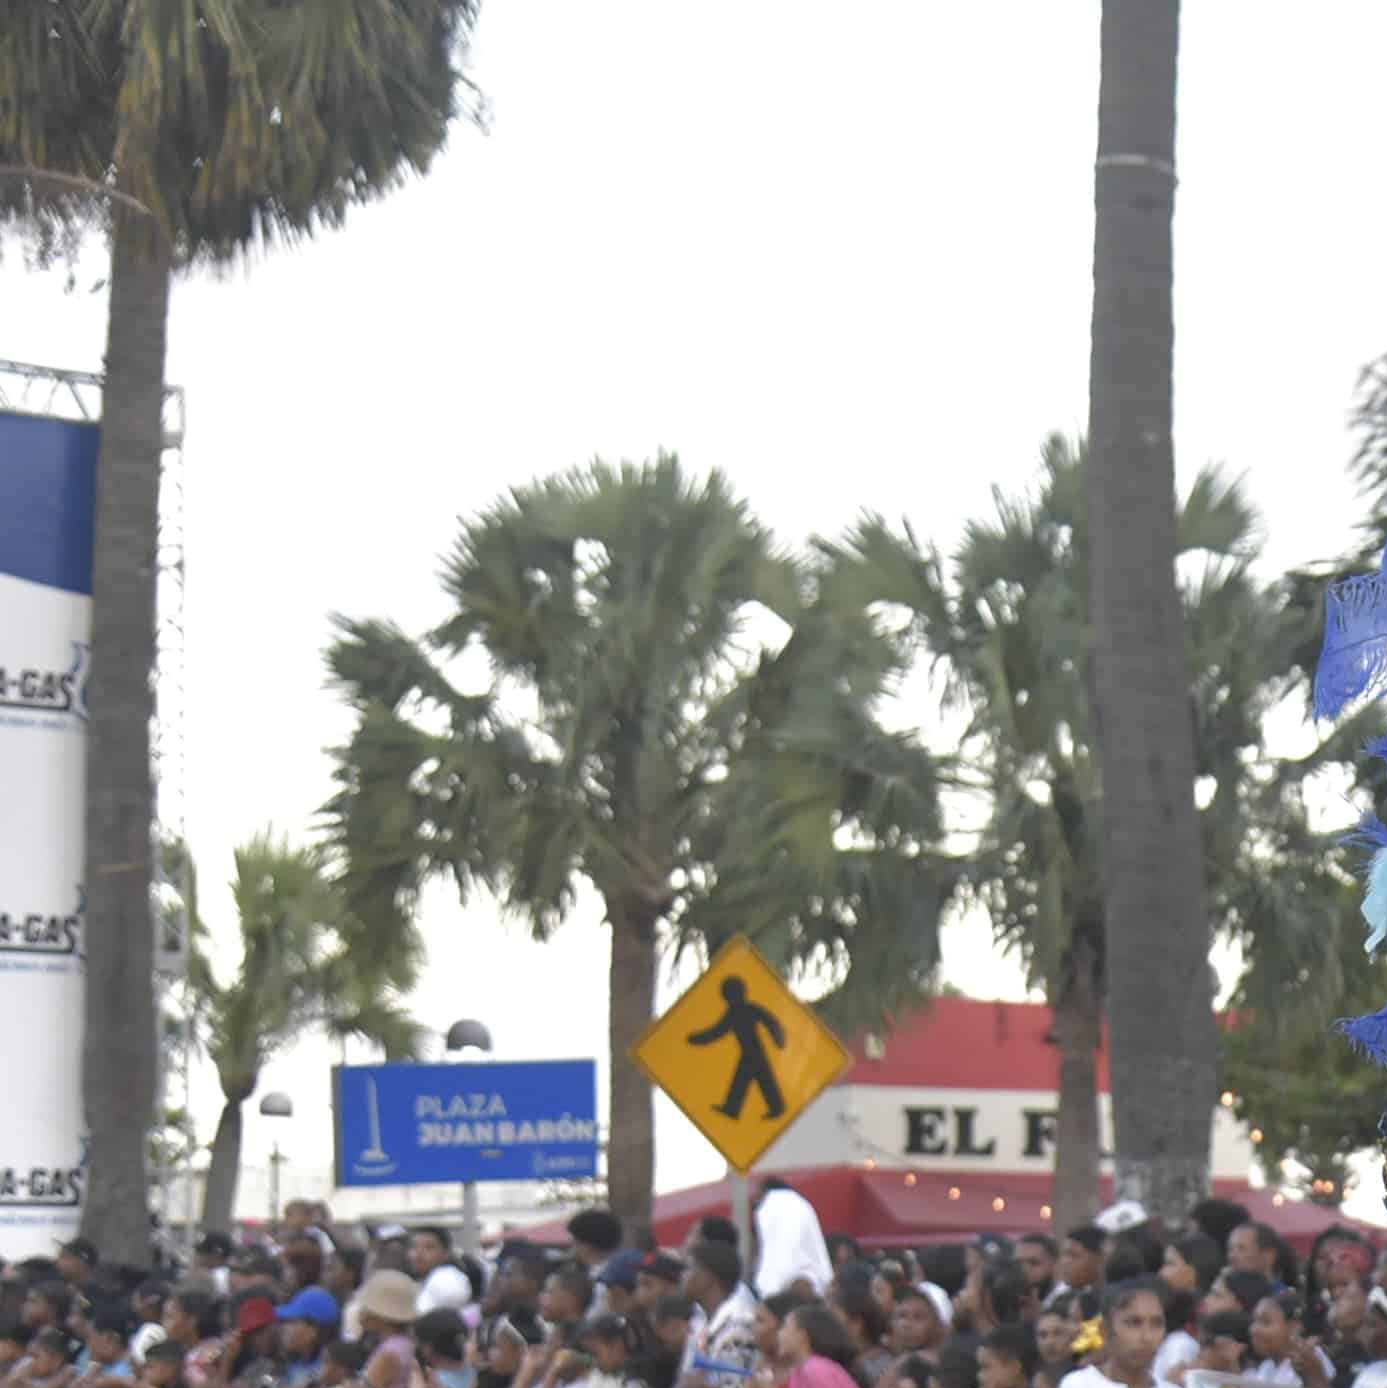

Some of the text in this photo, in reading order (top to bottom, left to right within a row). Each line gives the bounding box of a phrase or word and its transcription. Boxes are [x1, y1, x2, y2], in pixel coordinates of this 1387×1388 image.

[416, 1094, 508, 1118] PLAZA
[417, 1110, 600, 1147] JUAN BARÓN
[904, 1106, 995, 1156] EL
